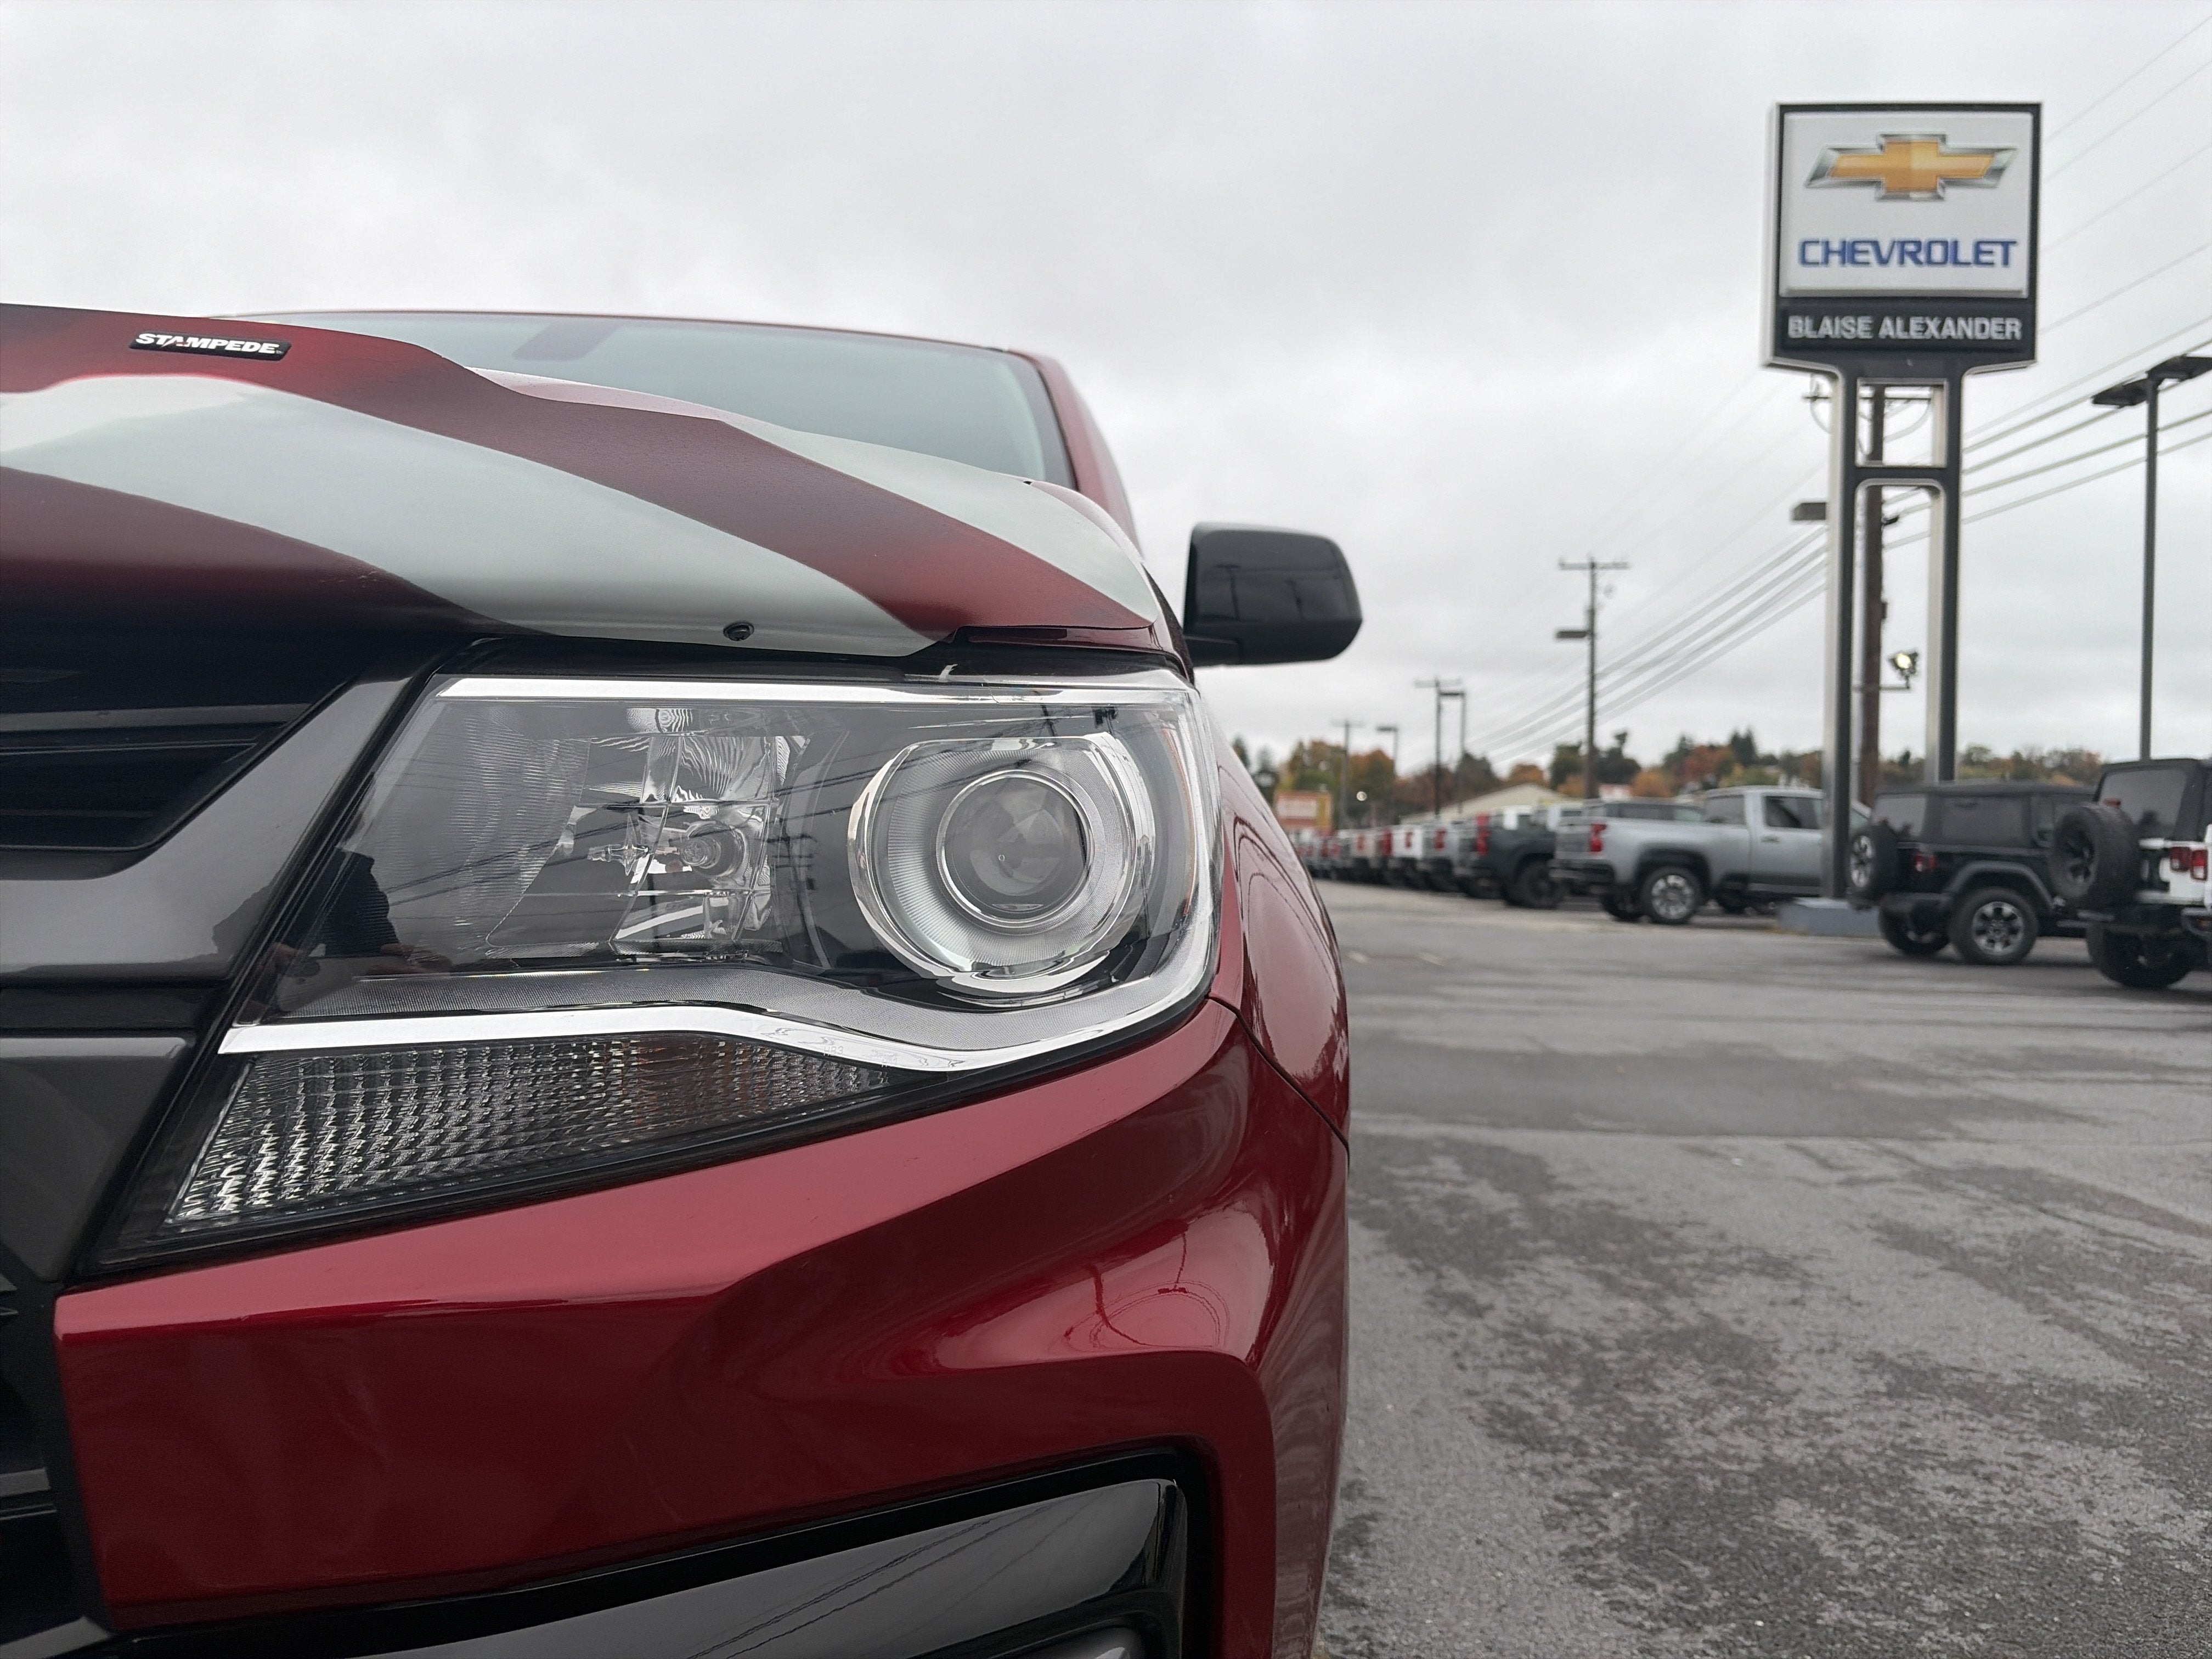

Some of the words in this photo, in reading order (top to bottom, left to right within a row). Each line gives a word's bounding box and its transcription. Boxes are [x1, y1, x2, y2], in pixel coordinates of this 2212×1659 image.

[1798, 239, 2017, 267] CHEVROLET
[1787, 315, 1873, 339] BLAISE
[1878, 316, 2022, 340] ALEXANDER
[136, 333, 280, 354] STAMPEDE
